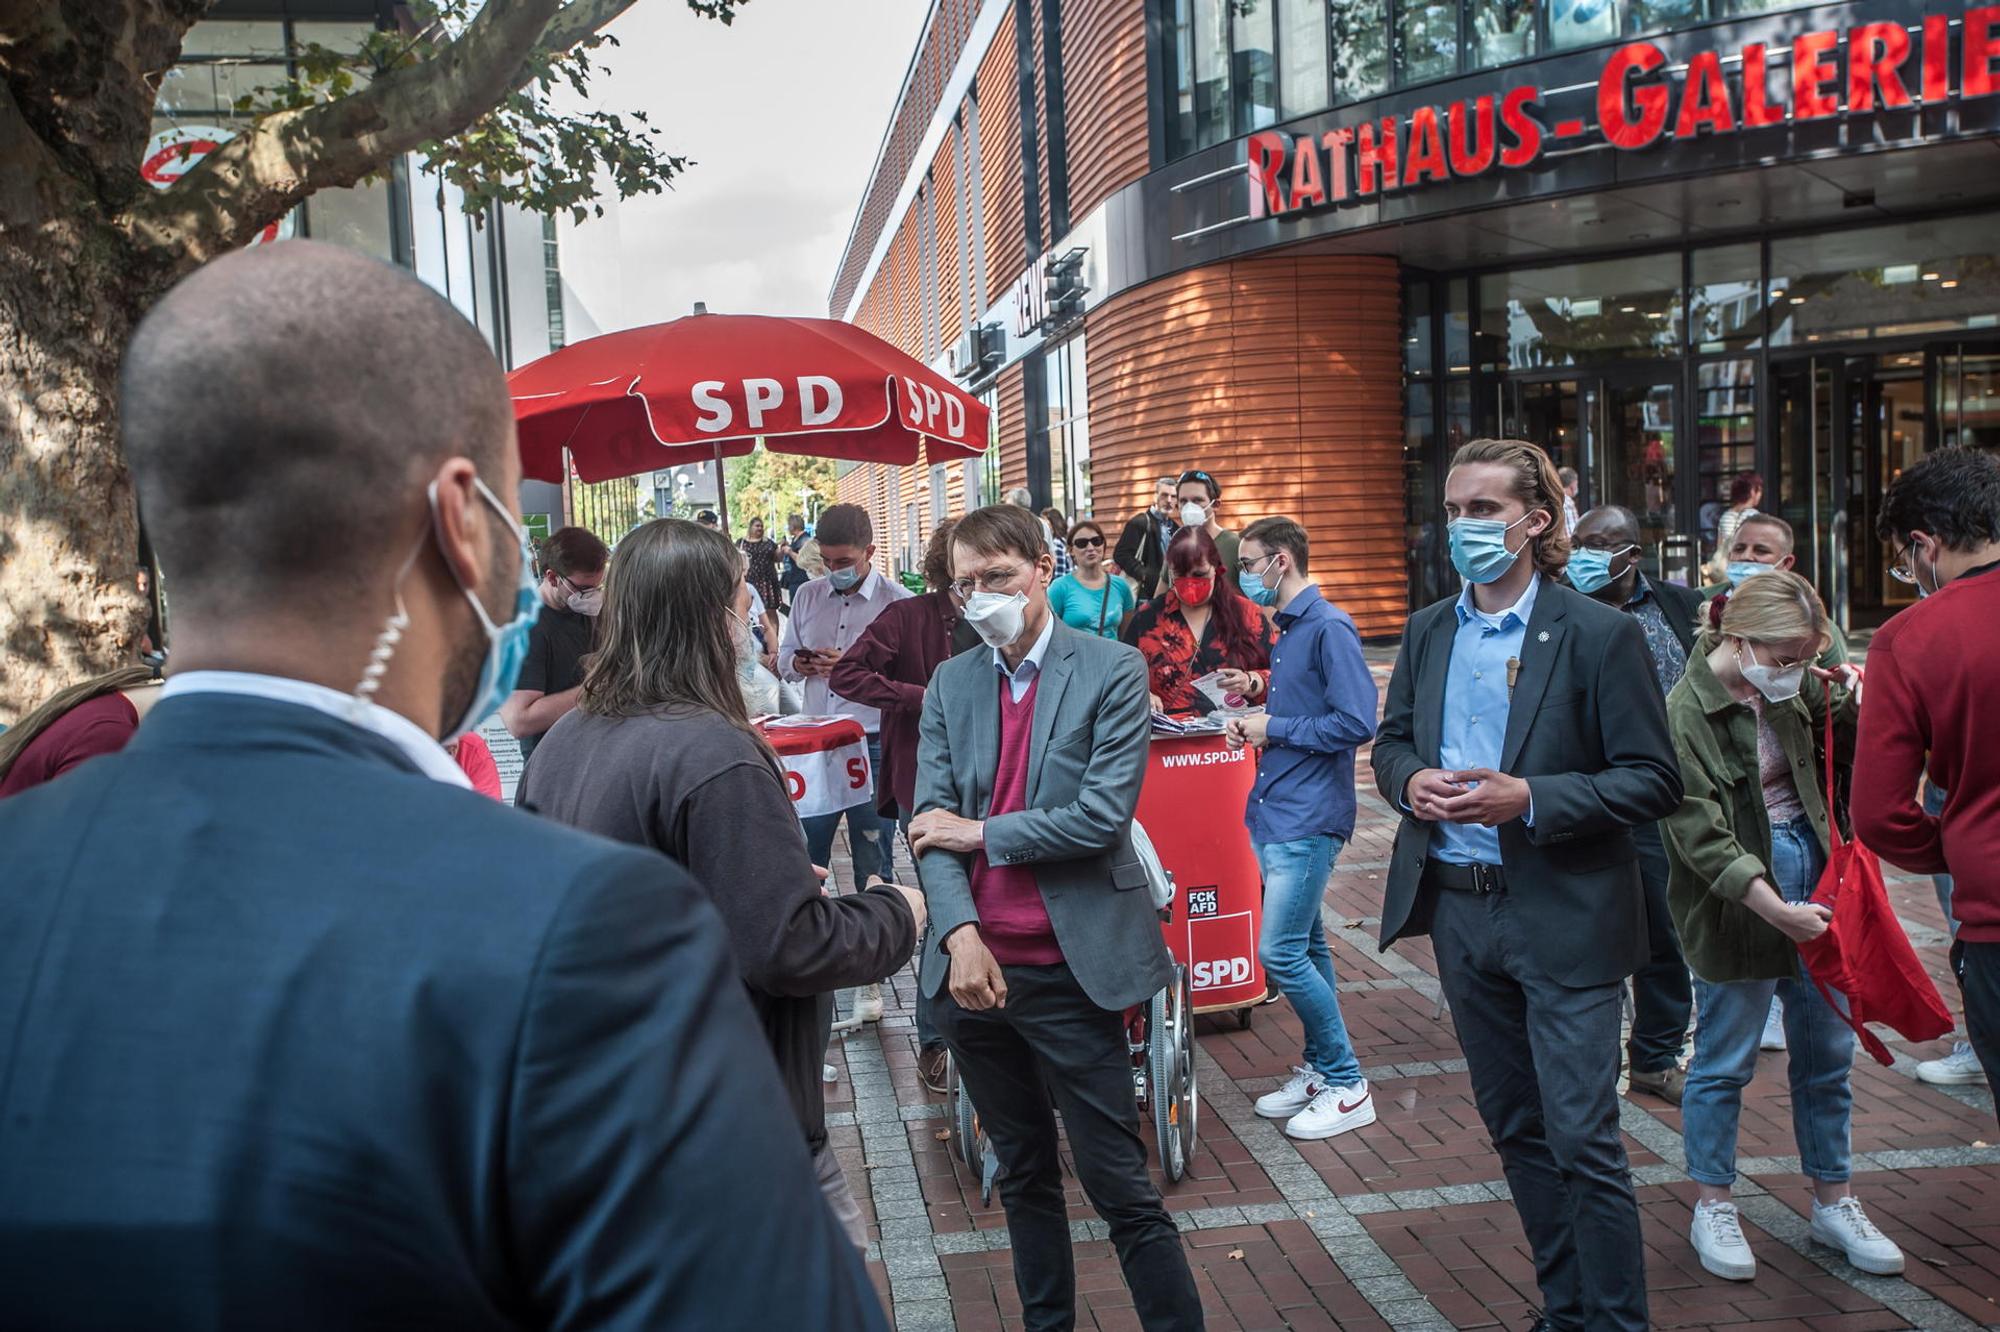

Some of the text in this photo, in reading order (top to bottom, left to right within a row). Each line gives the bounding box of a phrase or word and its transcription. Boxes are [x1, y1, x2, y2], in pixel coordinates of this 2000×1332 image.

[1249, 5, 2000, 219] RATHAUS-GALERIE
[691, 375, 844, 433] SPD
[903, 376, 965, 438] SPD
[1162, 749, 1245, 768] WWW.SPD.DE
[1189, 891, 1216, 903] FCK
[1190, 902, 1217, 913] AFD
[1193, 957, 1250, 987] SPD
